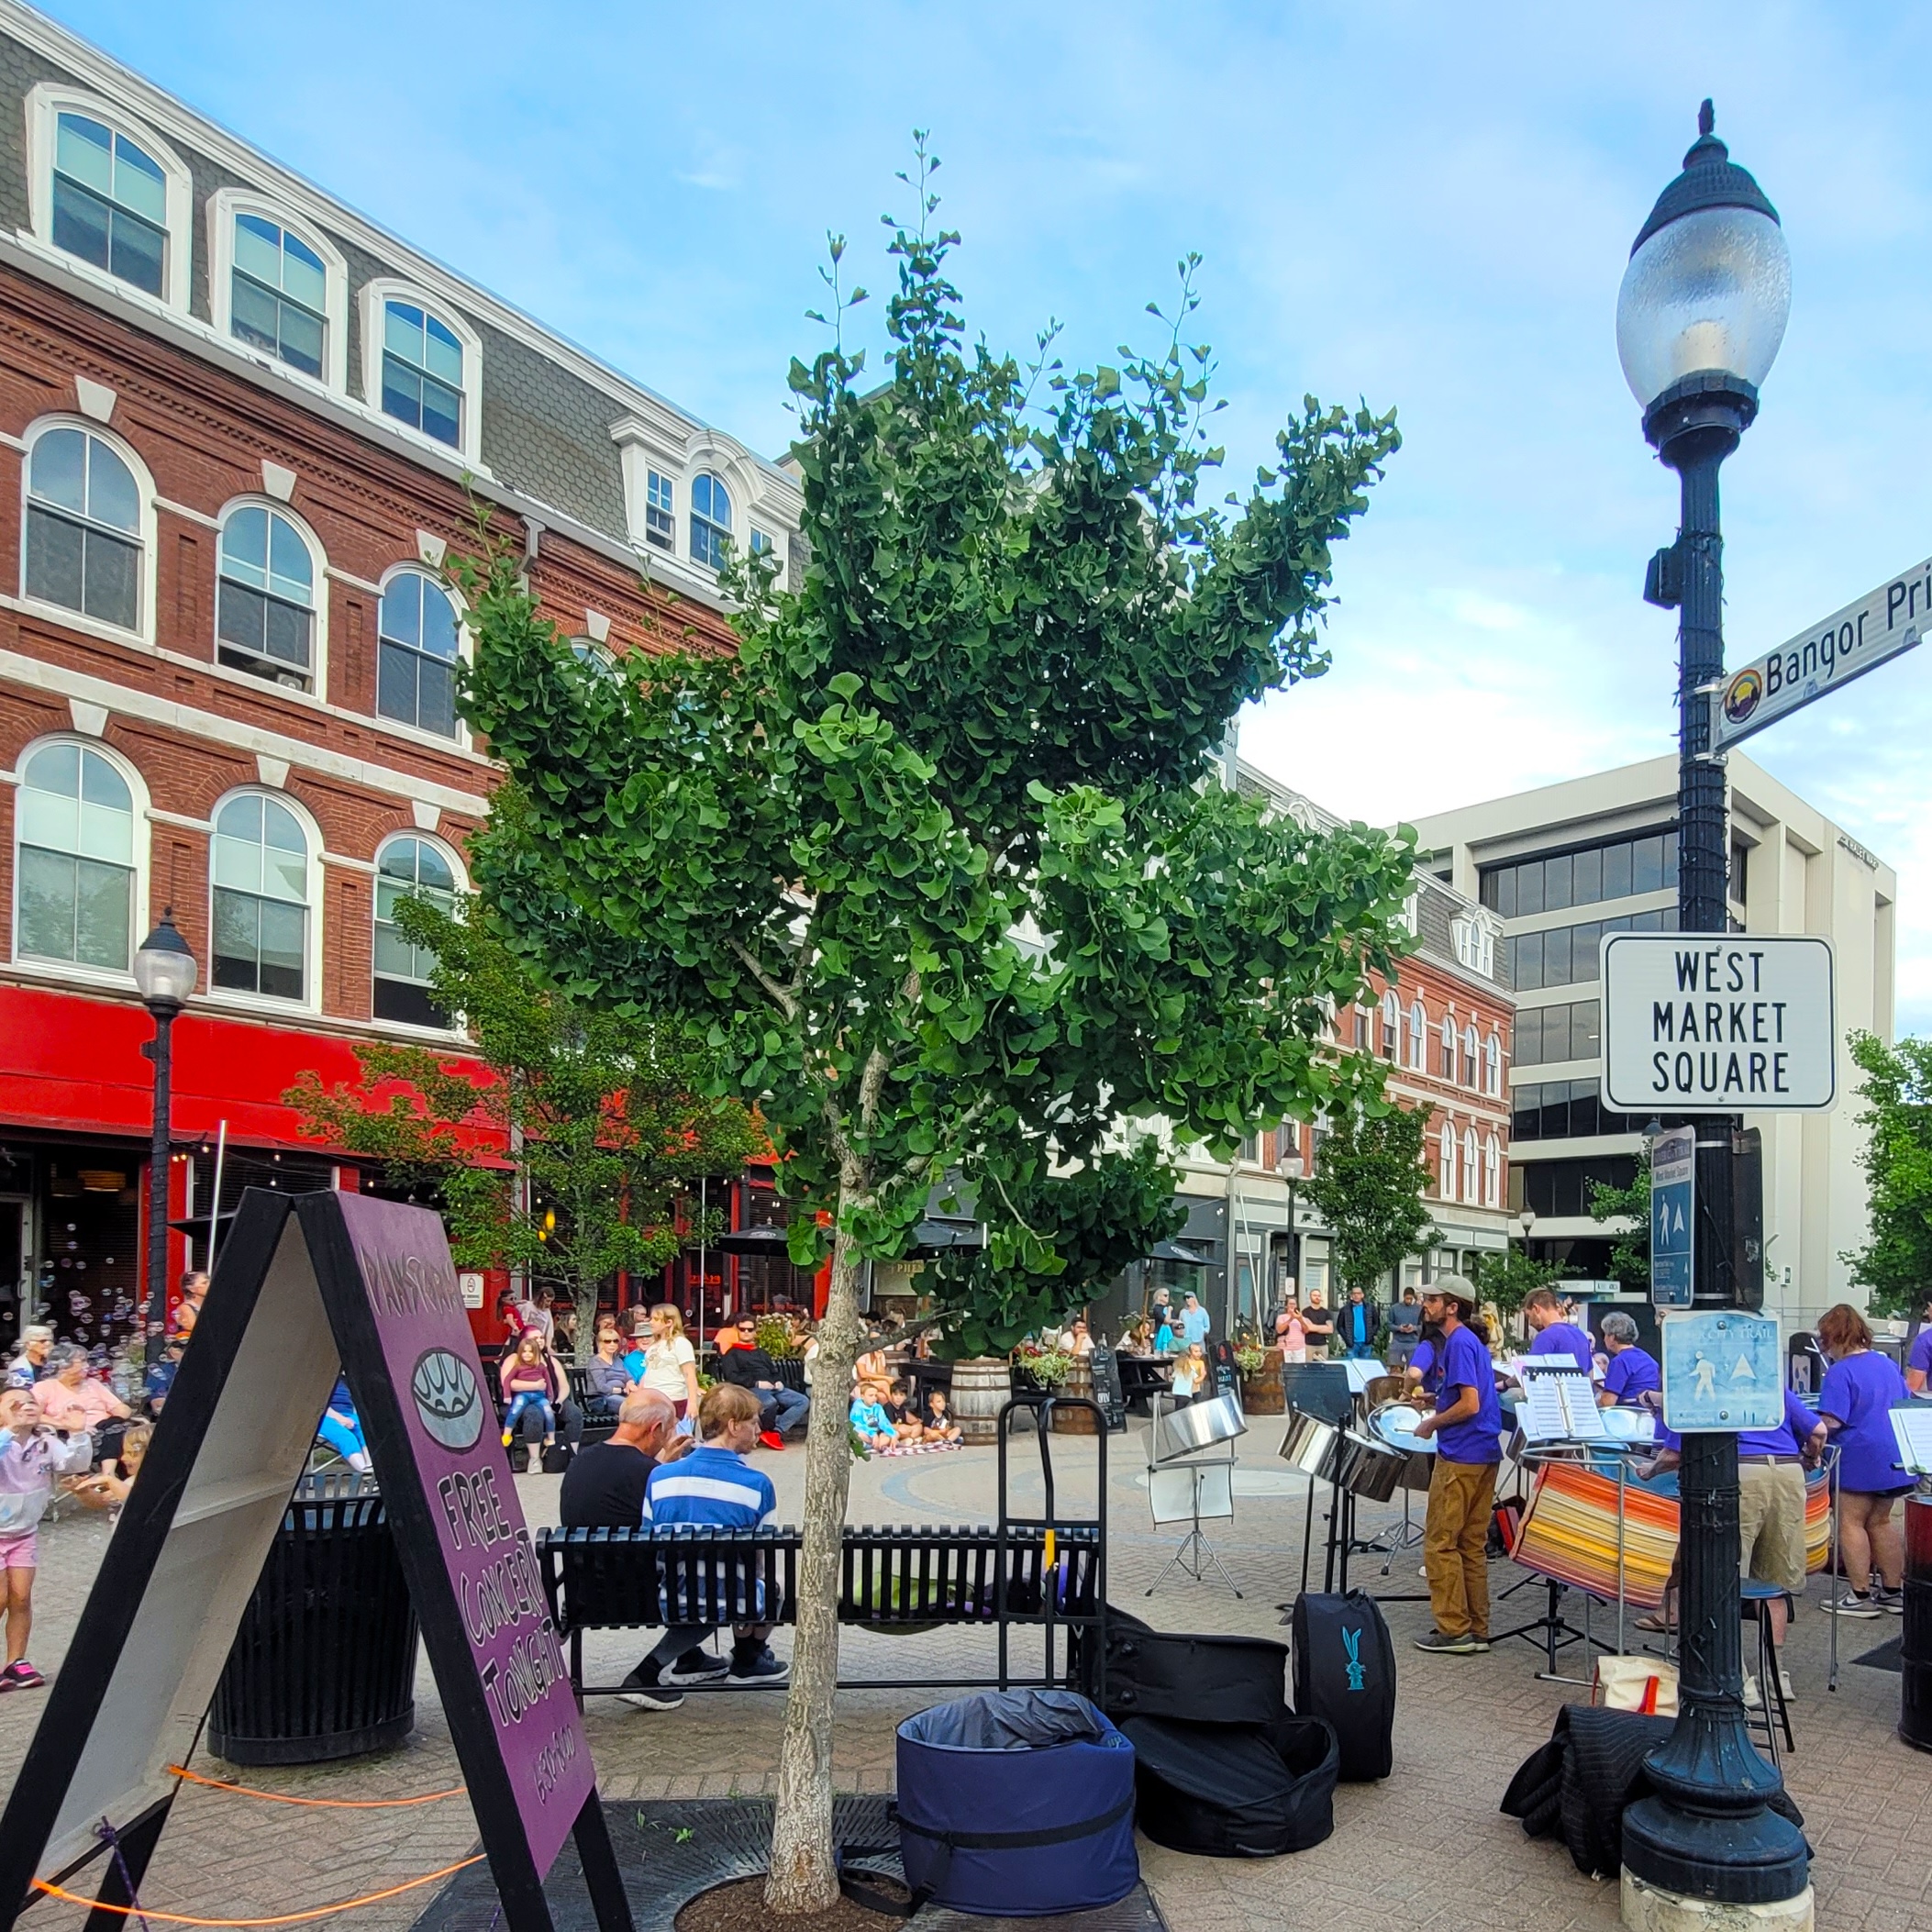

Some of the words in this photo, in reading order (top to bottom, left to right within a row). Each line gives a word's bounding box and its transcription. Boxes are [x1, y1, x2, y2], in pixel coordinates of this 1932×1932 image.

[1766, 610, 1870, 697] Bangor
[1888, 563, 1931, 631] Pri
[1675, 951, 1764, 993] WEST
[1653, 1002, 1786, 1043] MARKET
[1652, 1051, 1789, 1094] SQUARE
[1740, 1328, 1773, 1338] TRAIL
[437, 1466, 513, 1552] FREE
[461, 1527, 544, 1648] CONCERT
[481, 1616, 564, 1727] TONIGHT
